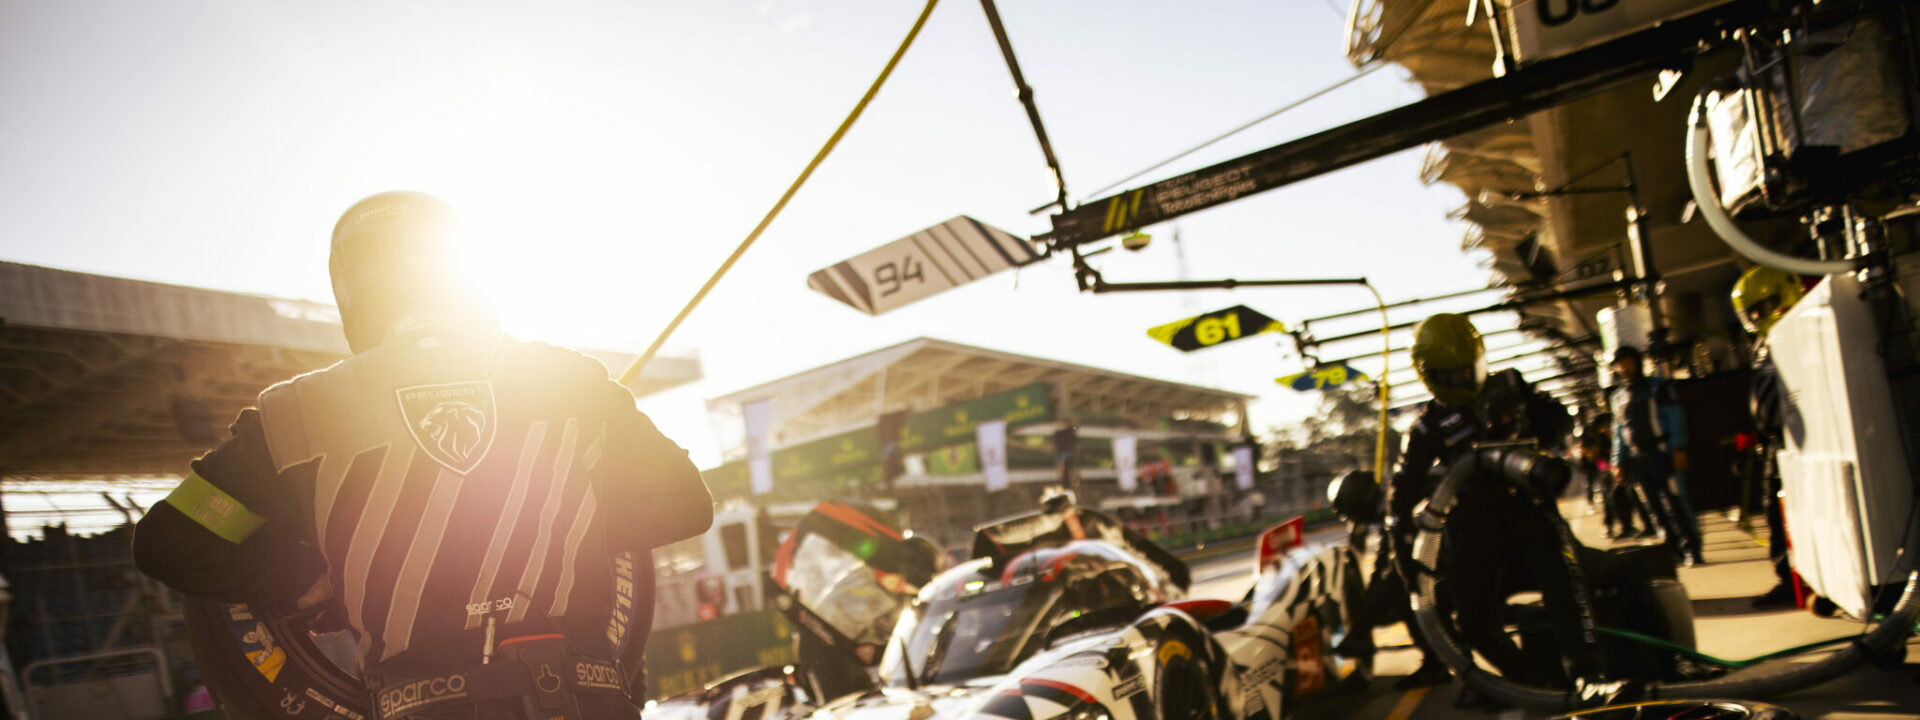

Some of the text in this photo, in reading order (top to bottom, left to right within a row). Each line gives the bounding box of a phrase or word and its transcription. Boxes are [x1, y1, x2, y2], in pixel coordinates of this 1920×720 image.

[1156, 166, 1254, 202] PEUGEOT
[872, 254, 925, 297] 94
[1194, 312, 1242, 346] 61
[405, 386, 483, 401] PEUGEOT
[1310, 364, 1348, 390] 79
[575, 661, 619, 687] sparco
[379, 673, 467, 717] sparco
